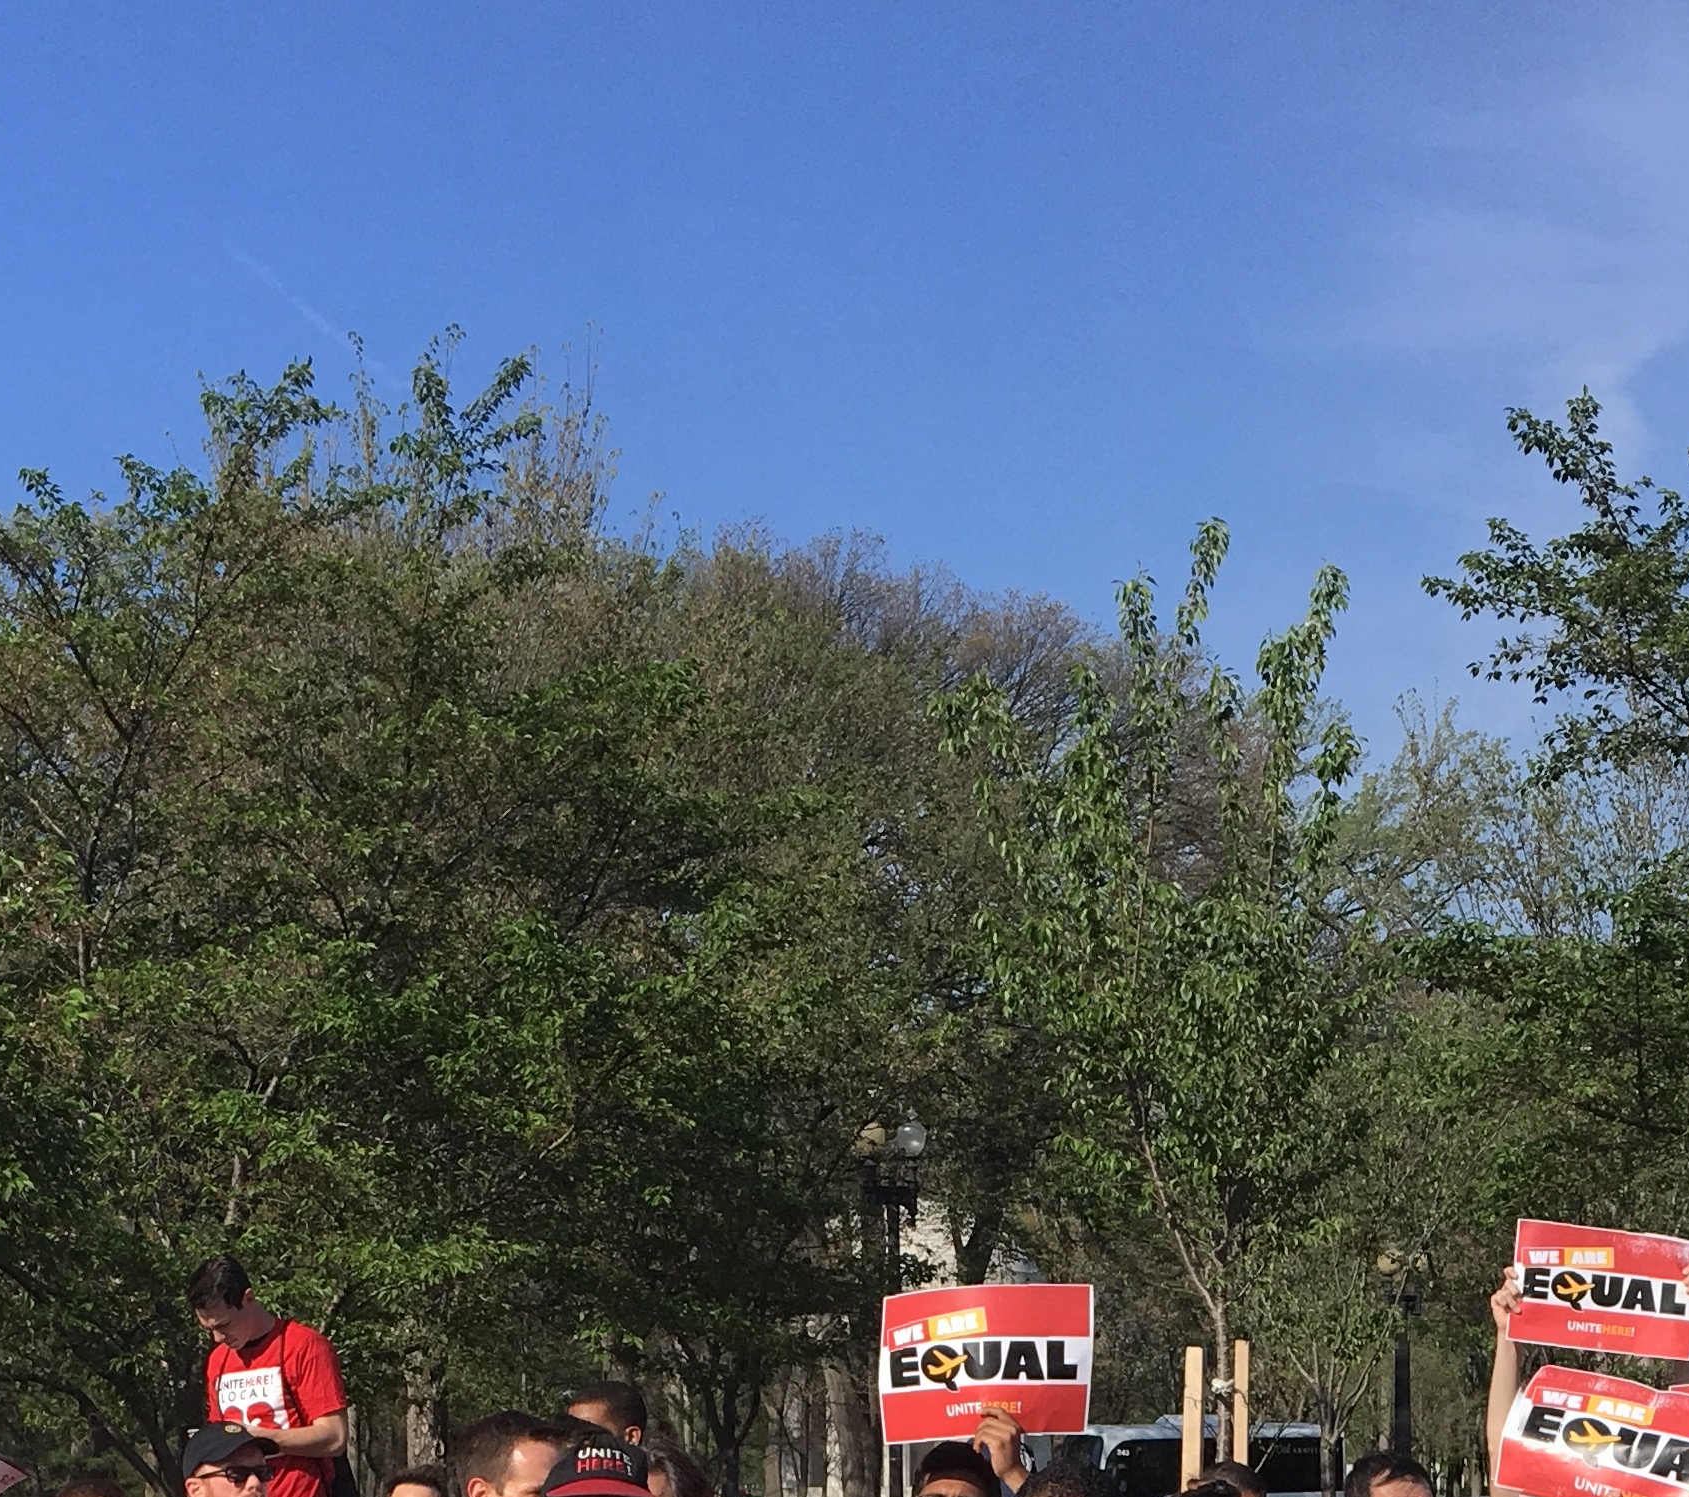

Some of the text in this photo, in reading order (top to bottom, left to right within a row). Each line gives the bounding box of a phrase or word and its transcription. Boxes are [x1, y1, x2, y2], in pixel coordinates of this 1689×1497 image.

[1528, 1250, 1607, 1265] WE ARE
[1522, 1267, 1686, 1316] EQUAL
[893, 1312, 978, 1346] WE ARE
[1567, 1320, 1635, 1338] UNITEHERE!
[889, 1340, 1078, 1391] EQUAL
[221, 1387, 268, 1403] LOCAL
[1542, 1390, 1647, 1421] WE ARE
[577, 1446, 632, 1464] UNITE
[576, 1459, 632, 1477] HERE!
